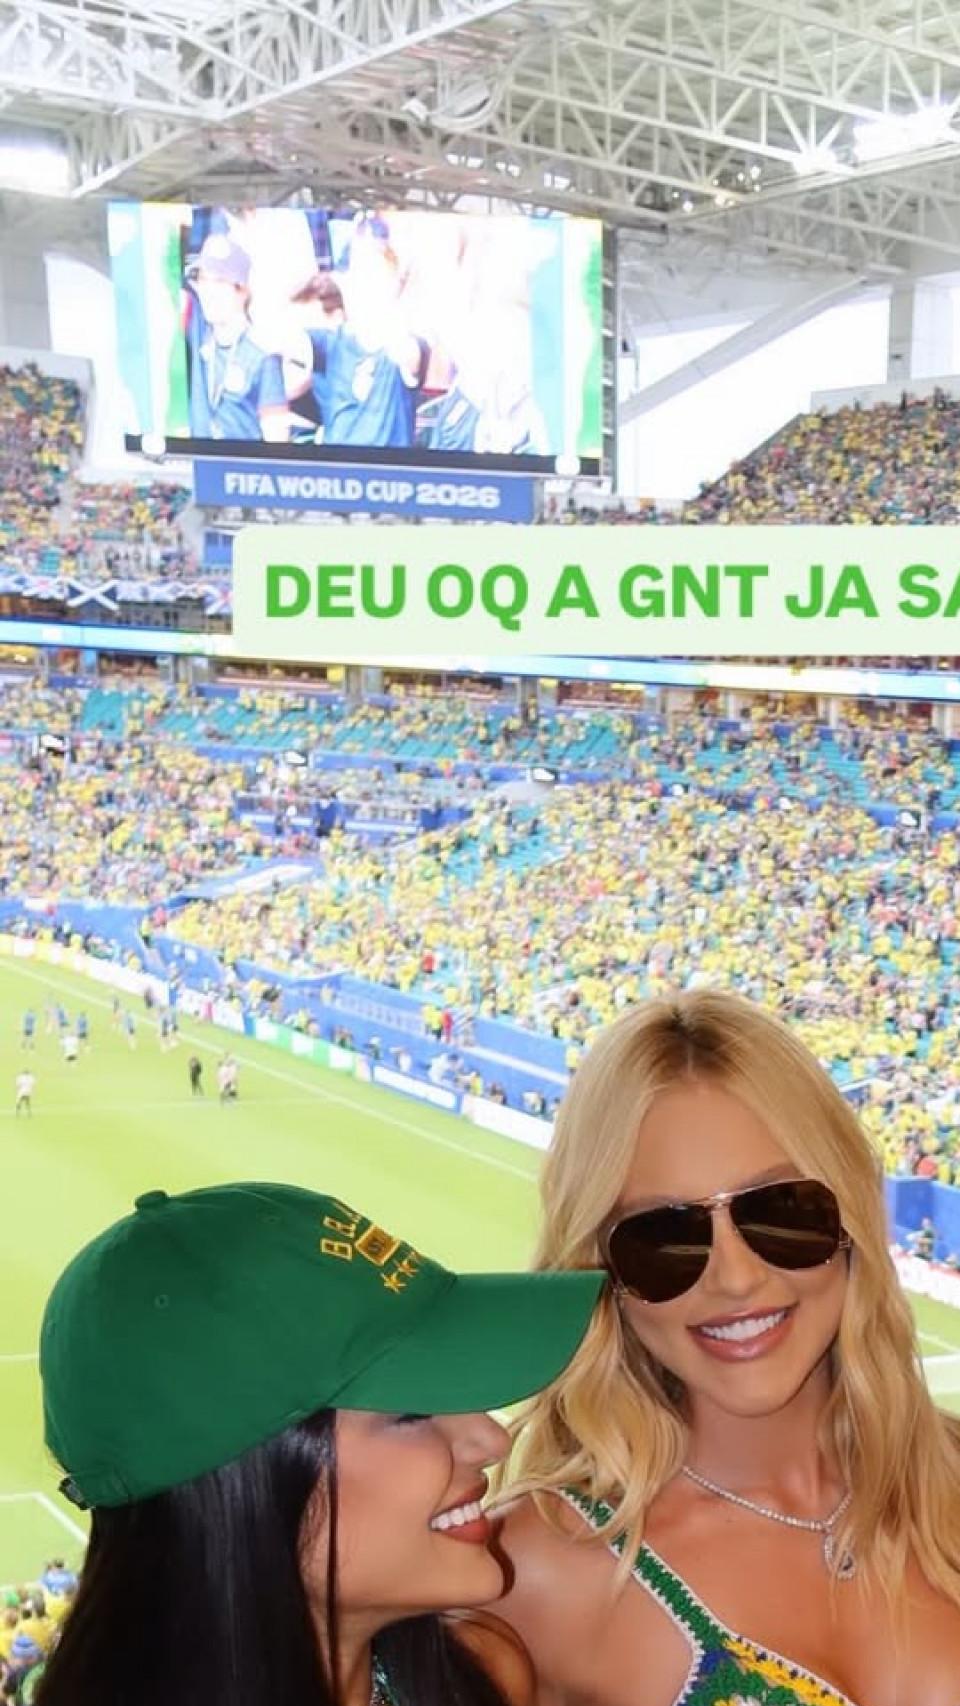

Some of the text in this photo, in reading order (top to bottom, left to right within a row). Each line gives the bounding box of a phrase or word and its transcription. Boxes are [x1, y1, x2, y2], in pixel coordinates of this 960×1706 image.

[224, 472, 501, 509] FIFA WORLD CUP 2026
